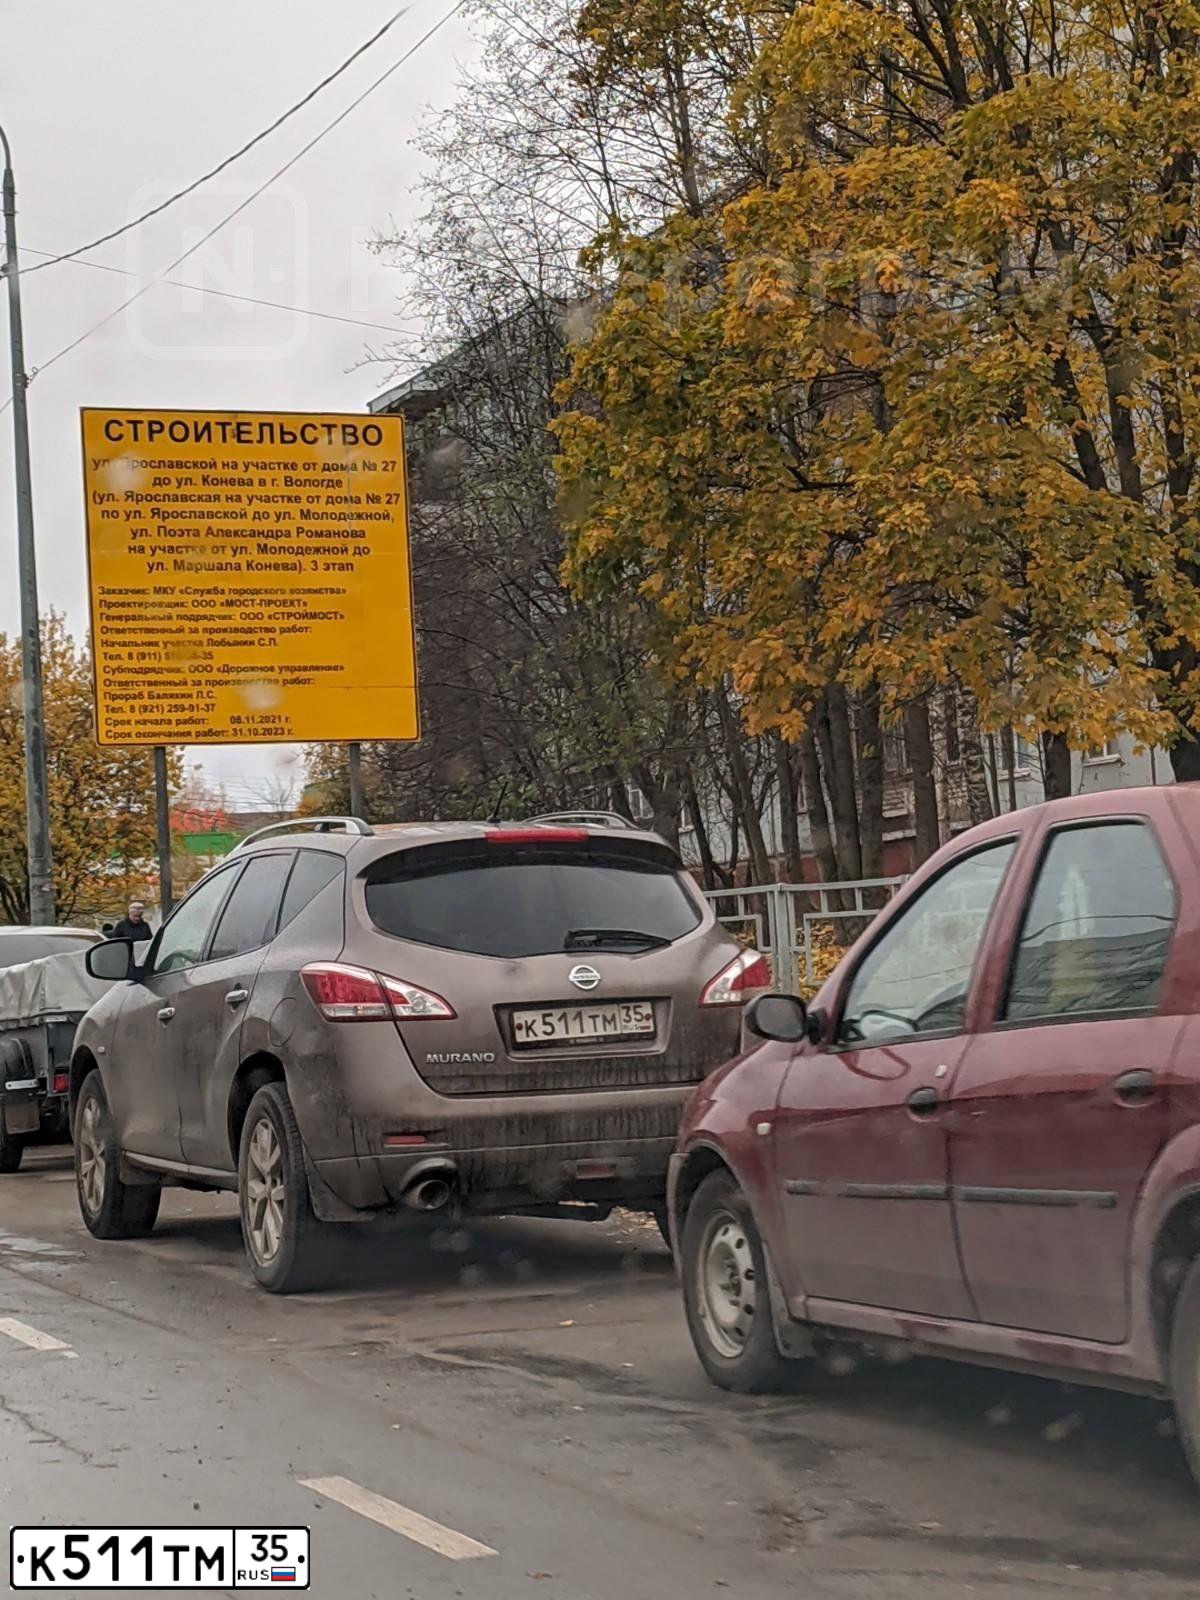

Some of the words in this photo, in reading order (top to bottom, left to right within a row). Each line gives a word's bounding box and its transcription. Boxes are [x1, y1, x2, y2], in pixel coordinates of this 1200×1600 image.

[104, 419, 383, 446] СТРОИТЕЛЬСТВО
[91, 458, 114, 472] ул
[221, 461, 238, 470] на
[242, 461, 298, 473] участке
[302, 462, 317, 471] от
[321, 463, 357, 473] дома
[362, 460, 377, 471] №
[382, 461, 397, 472] 27
[152, 477, 171, 488] до
[175, 477, 197, 489] ул.
[202, 475, 254, 487] Конева
[258, 478, 267, 487] в
[271, 478, 279, 487] г.
[284, 475, 343, 489] Вологде
[92, 491, 119, 505] (ул.
[123, 490, 221, 505] Ярославская
[225, 494, 242, 503] на
[246, 495, 302, 506] участке
[306, 495, 322, 504] от
[324, 495, 362, 506] дома
[365, 493, 381, 504] №
[385, 493, 400, 504] 27
[100, 510, 120, 519] по
[123, 510, 146, 521] ул.
[150, 507, 248, 522] Ярославской
[252, 511, 270, 522] до
[273, 511, 295, 523] ул.
[300, 509, 394, 524] Молодежной,
[130, 528, 152, 540] ул.
[156, 525, 200, 537] Поэта
[204, 526, 292, 541] Александра
[296, 526, 366, 539] Романова
[128, 545, 146, 554] на
[149, 545, 206, 557] участке
[210, 545, 226, 554] от
[230, 546, 252, 557] ул.
[256, 543, 348, 557] Молодежной
[352, 546, 371, 557] до
[146, 562, 168, 574] ул.
[172, 559, 241, 574] Маршала
[311, 560, 319, 571] 3
[323, 562, 354, 571] этап
[98, 586, 149, 595] Заказчик:
[153, 586, 176, 595] МКУ
[178, 586, 225, 597] «Служба
[228, 588, 286, 597] городского
[99, 599, 189, 610] Проектировщик:
[191, 599, 216, 608] ООО
[220, 599, 308, 608] «МОСТ-ПРОЕКТ»
[99, 612, 173, 623] Генеральный
[239, 611, 264, 620] ООО
[267, 610, 345, 620] «СТРОЙМОСТ»
[100, 625, 185, 635] Ответственный
[188, 626, 200, 634] за
[203, 626, 277, 635] производство
[279, 624, 312, 635] работ:
[101, 638, 160, 647] Начальник
[127, 651, 134, 660] 8
[136, 652, 162, 662] (911)
[188, 664, 213, 673] ООО
[103, 678, 188, 687] Ответственный
[282, 676, 315, 686] работ:
[104, 690, 144, 702] Прораб
[129, 704, 136, 713] 8
[138, 704, 164, 715] (921)
[105, 717, 132, 728] Срок
[137, 718, 172, 727] начала
[175, 716, 209, 727] работ:
[105, 729, 132, 740] Срок
[195, 728, 229, 739] работ:
[621, 1005, 644, 1024] 35
[425, 1052, 495, 1064] MURANO
